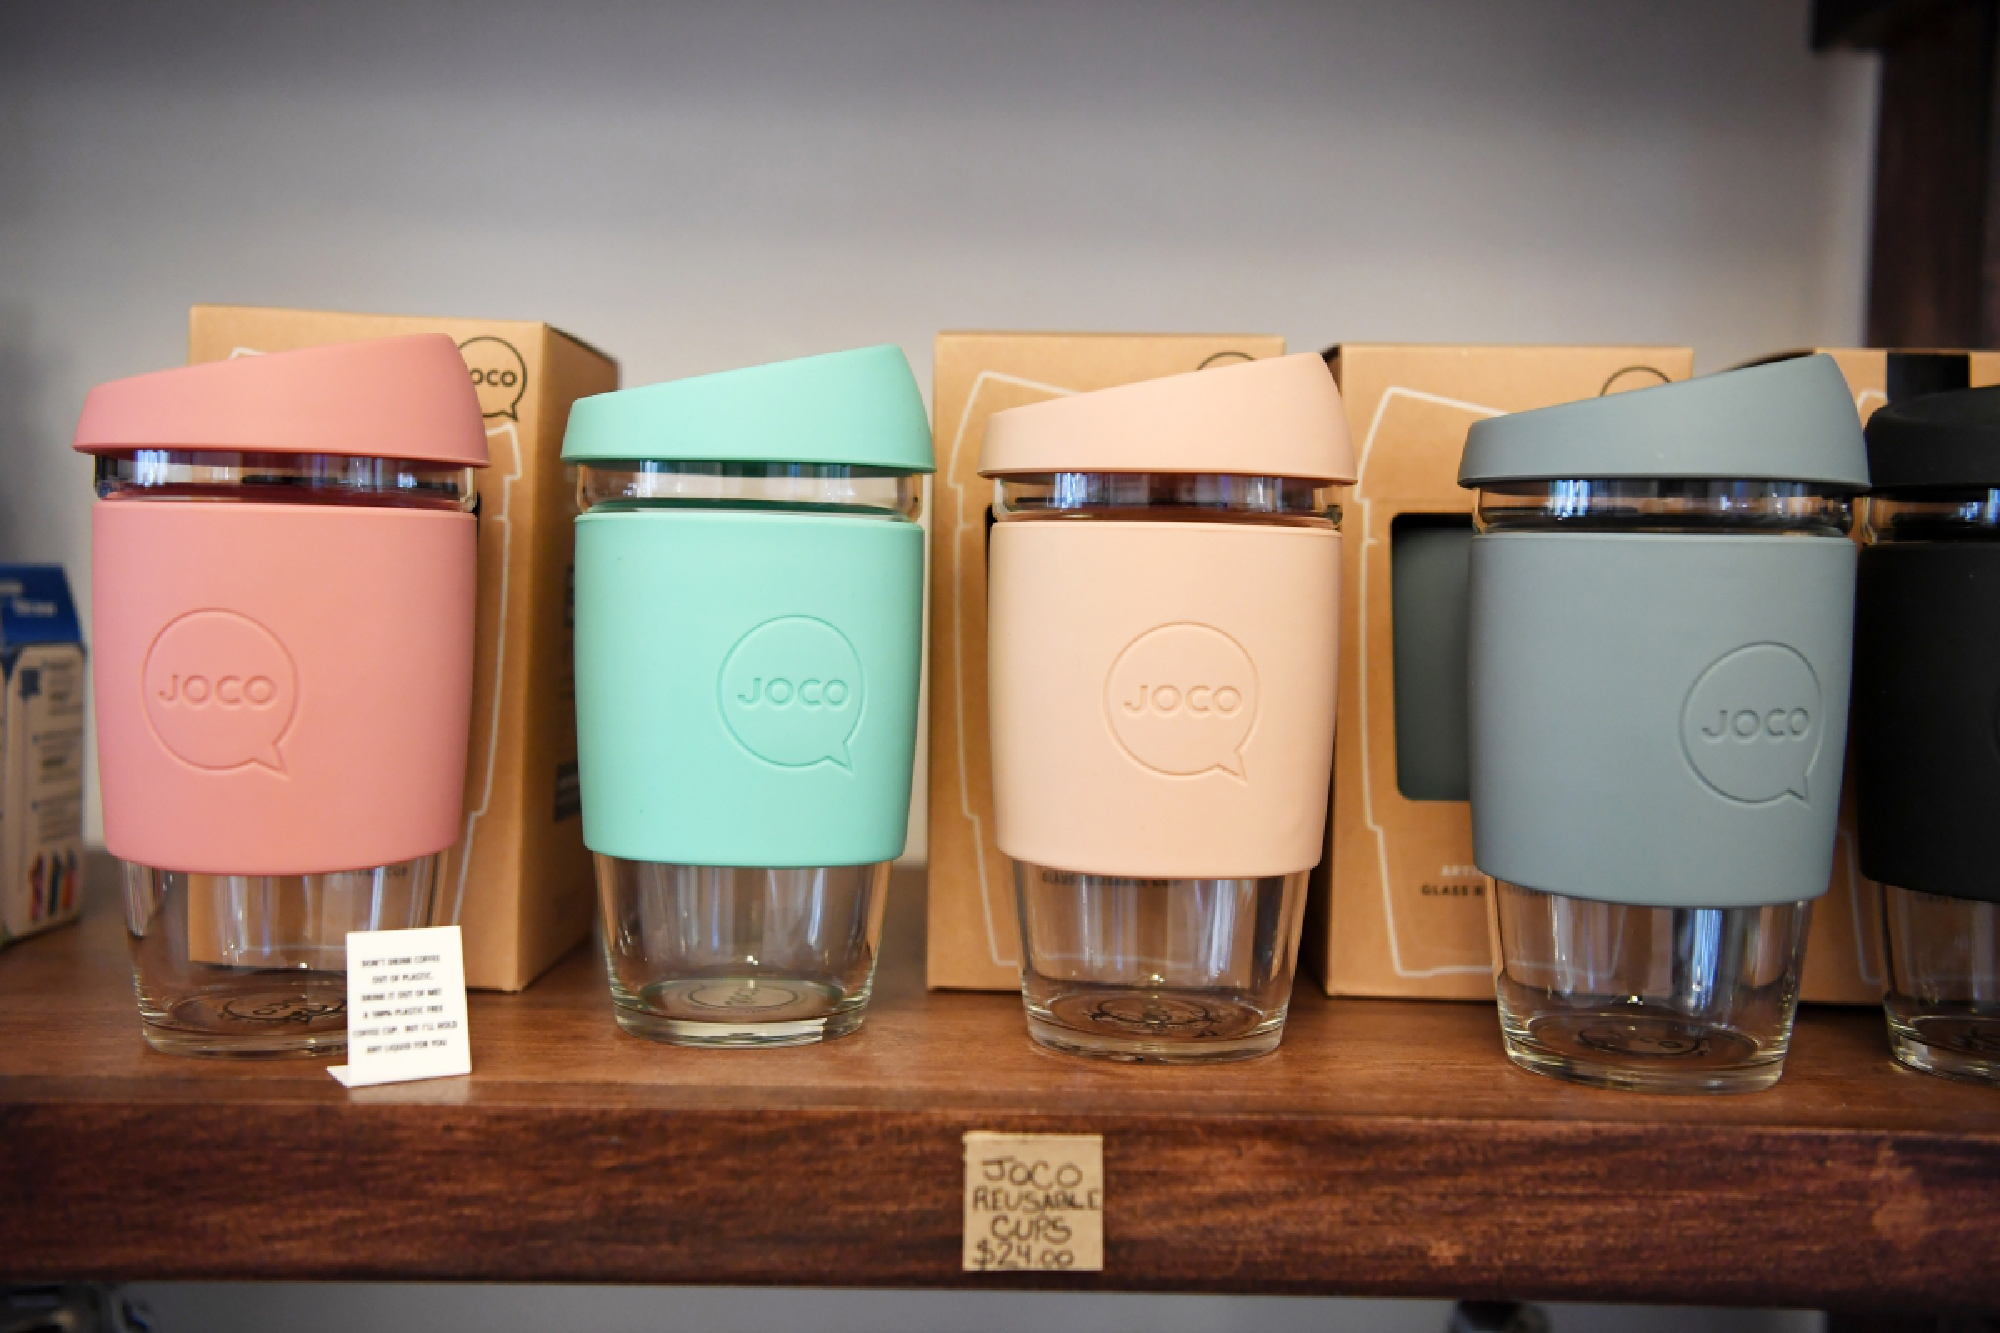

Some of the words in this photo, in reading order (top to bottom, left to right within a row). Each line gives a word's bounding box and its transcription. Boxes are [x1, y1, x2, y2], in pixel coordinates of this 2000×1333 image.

[468, 367, 517, 388] OCO
[158, 674, 277, 709] JOCO
[737, 677, 849, 709] JOCO
[1123, 684, 1243, 715] JOCO
[1702, 707, 1810, 740] JOCO
[981, 1156, 1083, 1191] JOCO
[972, 1185, 1102, 1214] REUSABLE
[990, 1214, 1073, 1245] CUPS
[972, 1238, 1075, 1271] $24.00
